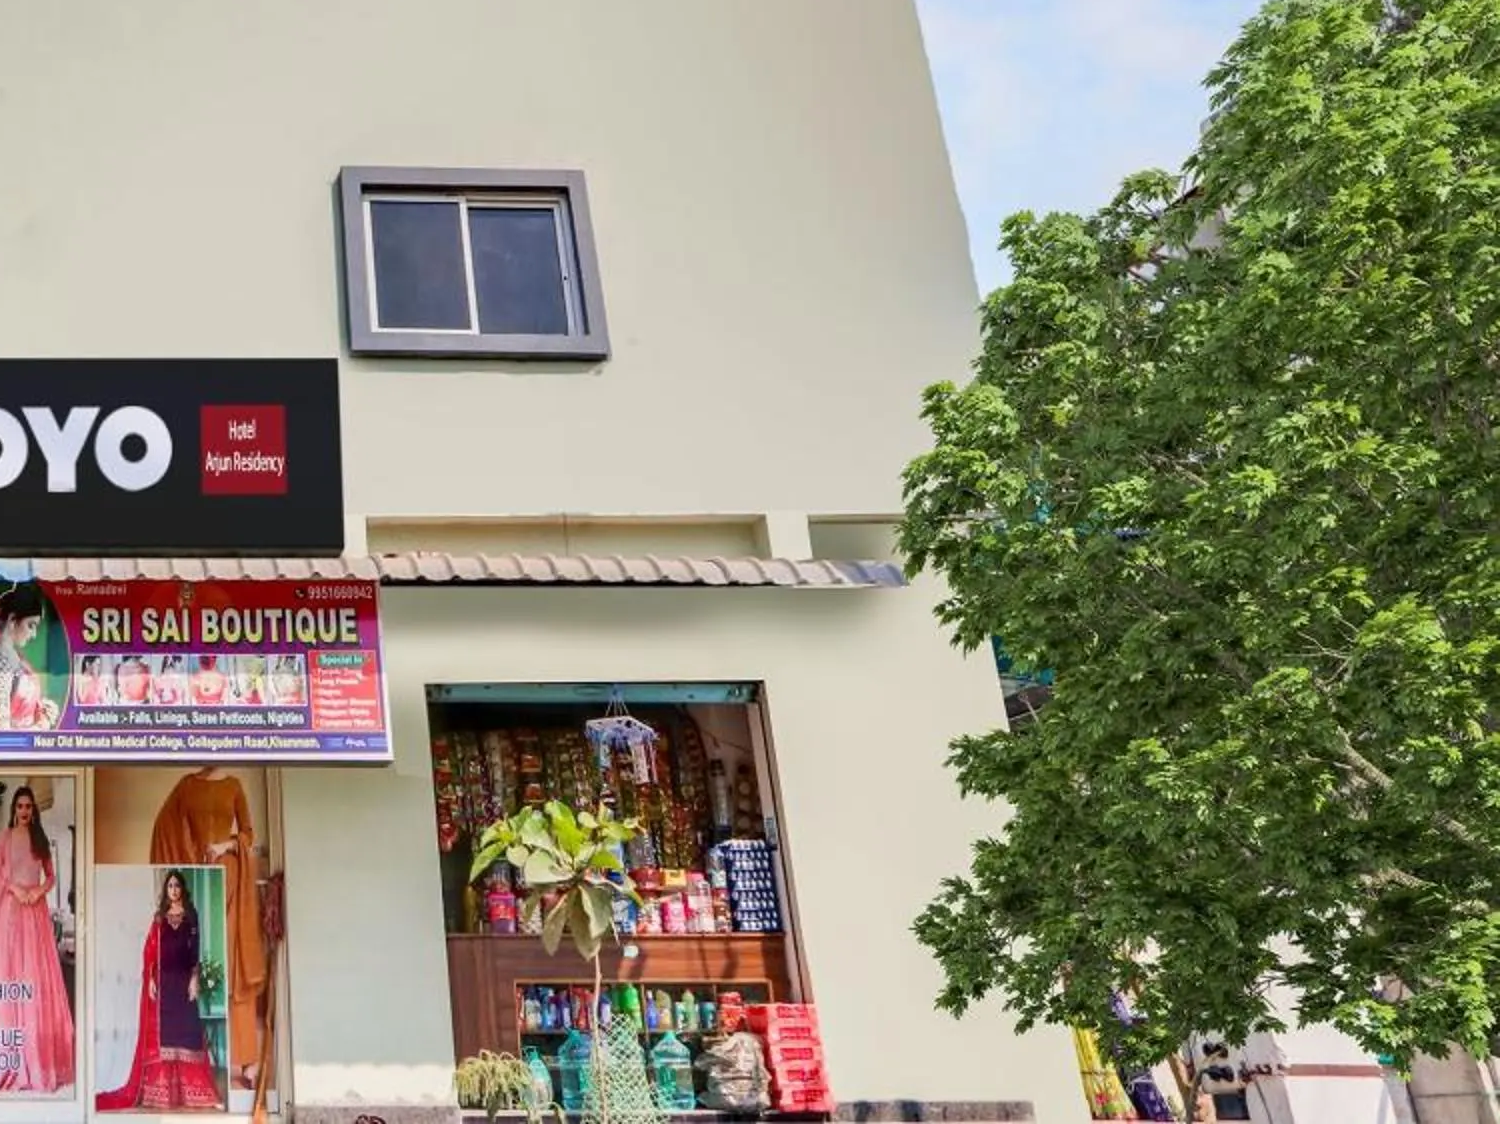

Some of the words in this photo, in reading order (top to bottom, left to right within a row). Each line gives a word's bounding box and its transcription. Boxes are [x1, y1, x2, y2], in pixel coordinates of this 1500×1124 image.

[228, 419, 257, 441] Hotel
[205, 450, 233, 477] Arjun
[233, 450, 285, 477] Residency
[82, 607, 131, 643] SRI
[141, 607, 191, 643] SAI
[201, 607, 358, 645] BOUTIQUE
[77, 711, 119, 724] Available
[57, 735, 74, 746] Old
[112, 736, 147, 747] Medical
